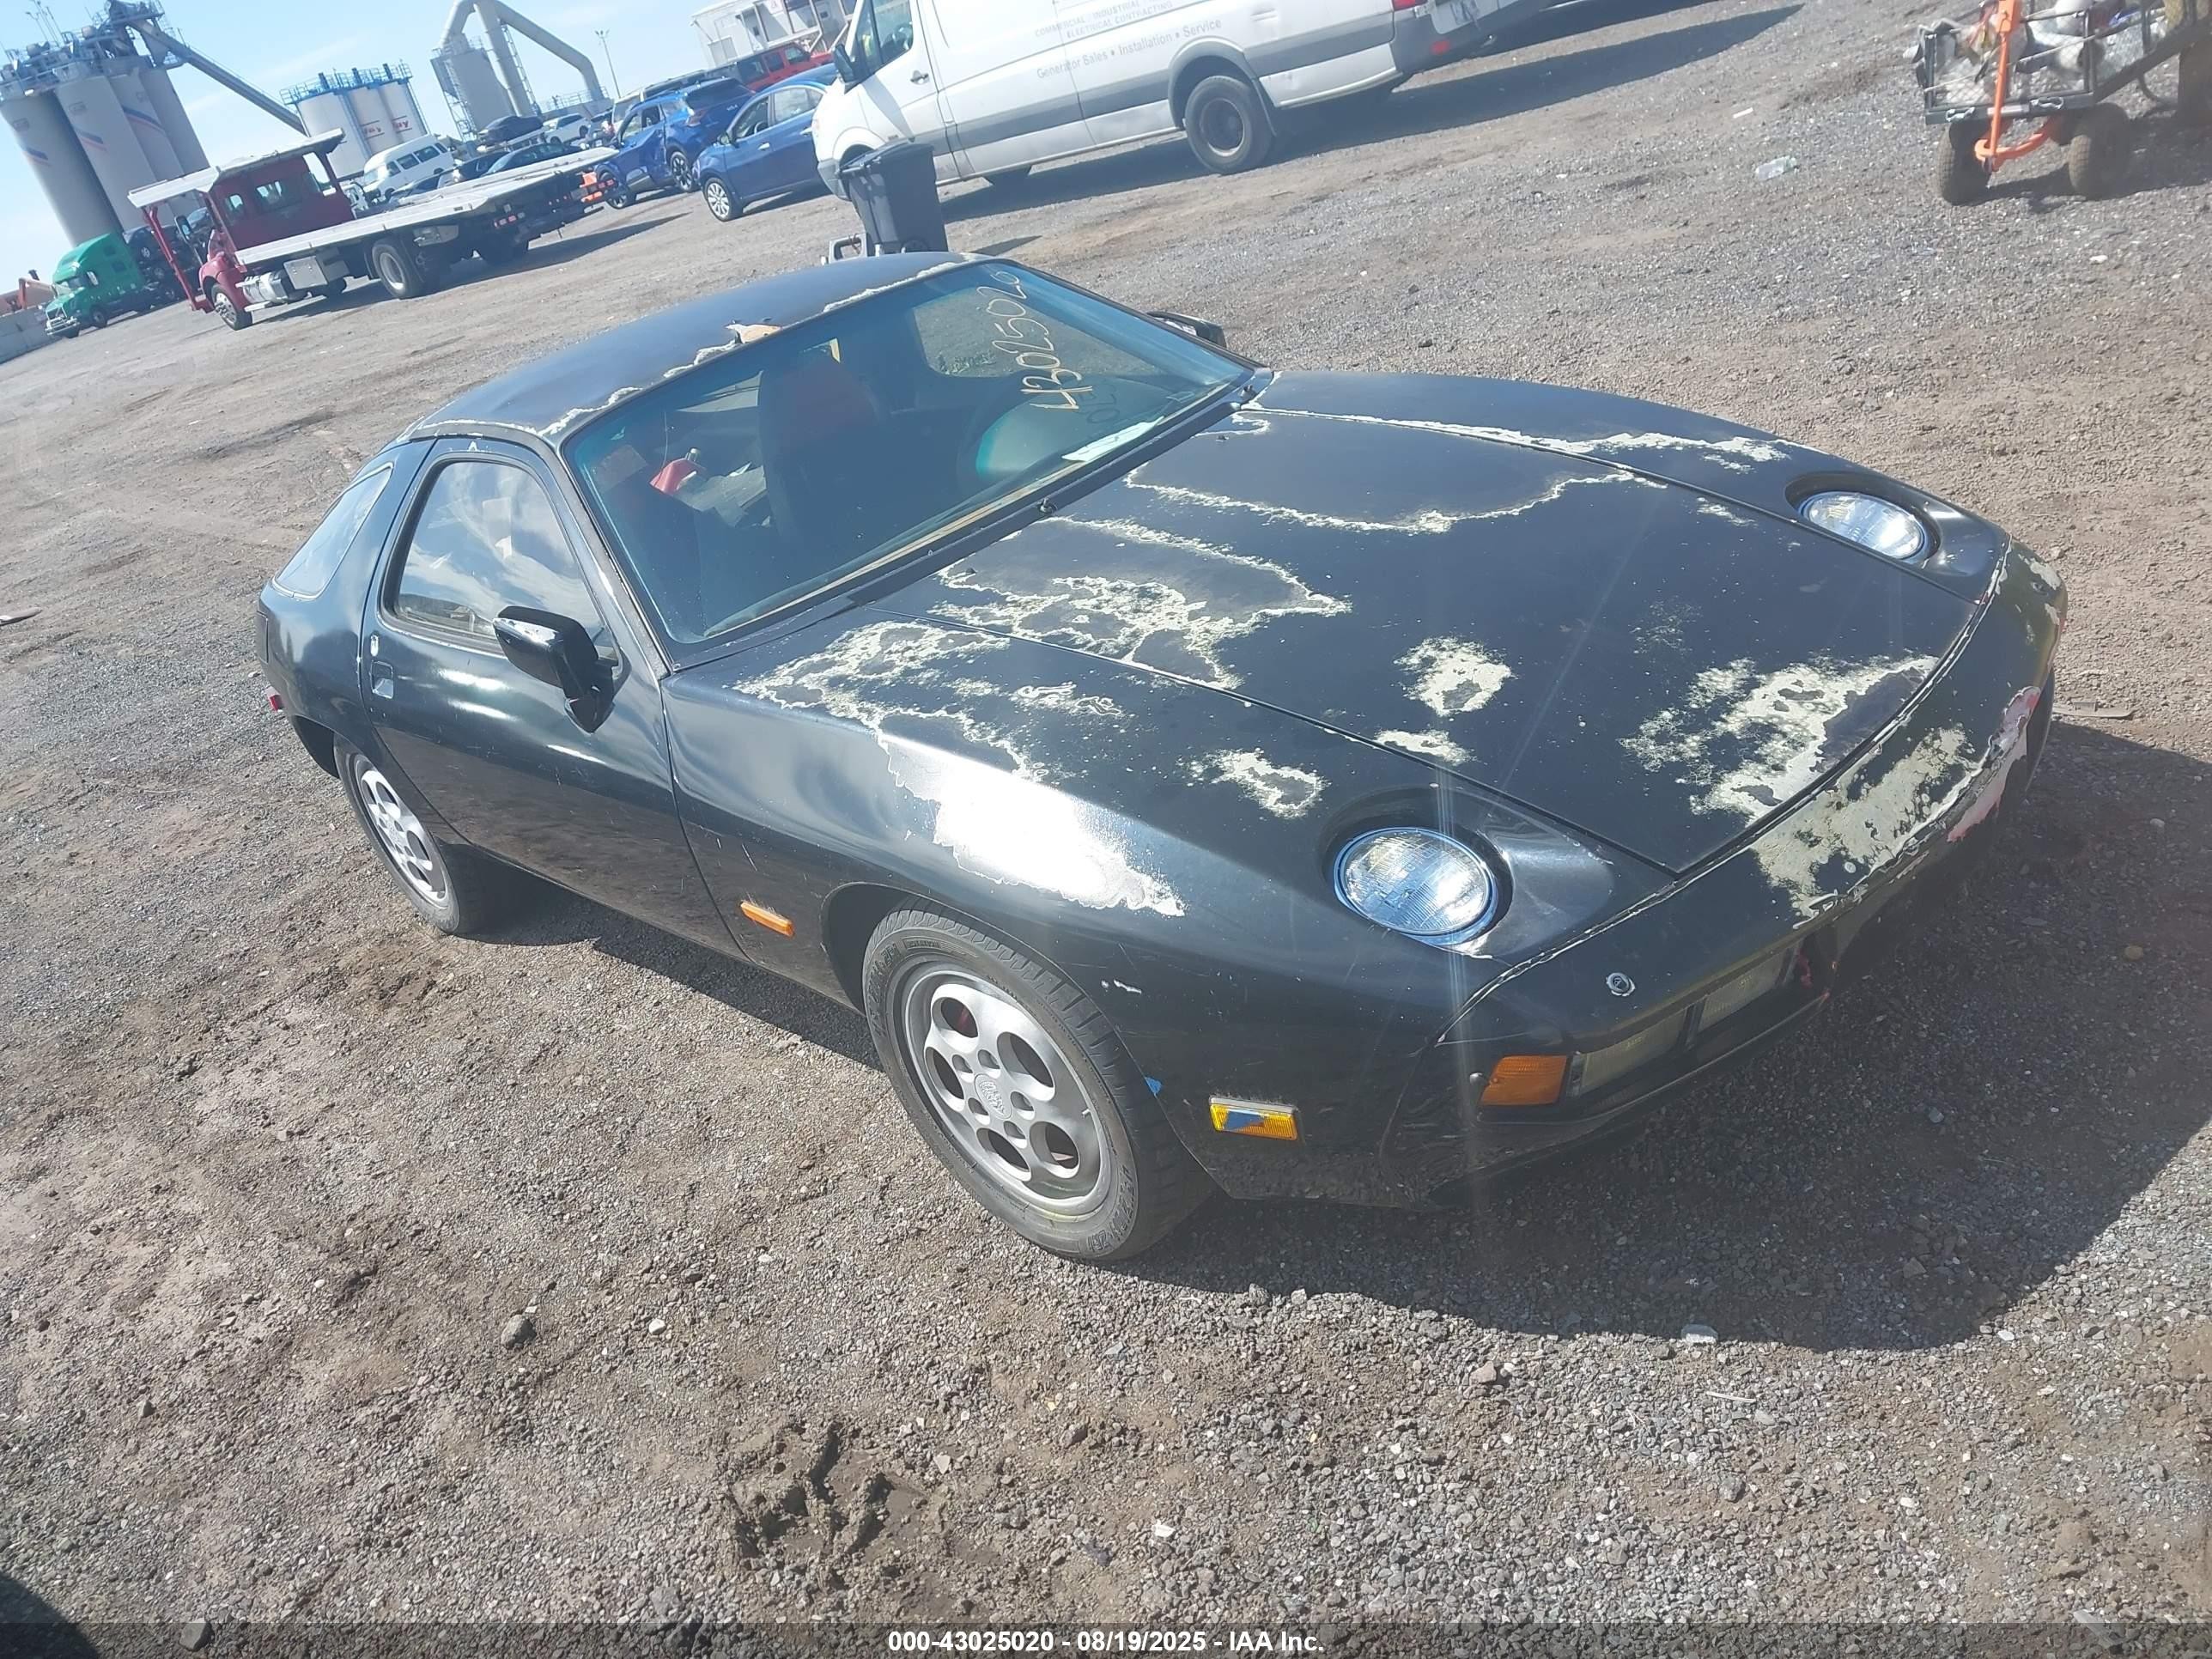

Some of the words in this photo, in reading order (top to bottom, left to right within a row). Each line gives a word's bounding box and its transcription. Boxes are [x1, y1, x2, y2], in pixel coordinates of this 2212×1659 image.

[1034, 17, 1085, 37] COMMERCIAL
[1092, 0, 1140, 19] INDUSTRIAL
[1066, 18, 1113, 39] ELECTRICAL
[1115, 1, 1173, 24] CONTRACTING
[1036, 58, 1082, 79] Generator
[1083, 50, 1109, 67] Sales
[1119, 33, 1173, 56] Installation
[1182, 18, 1222, 38] Service
